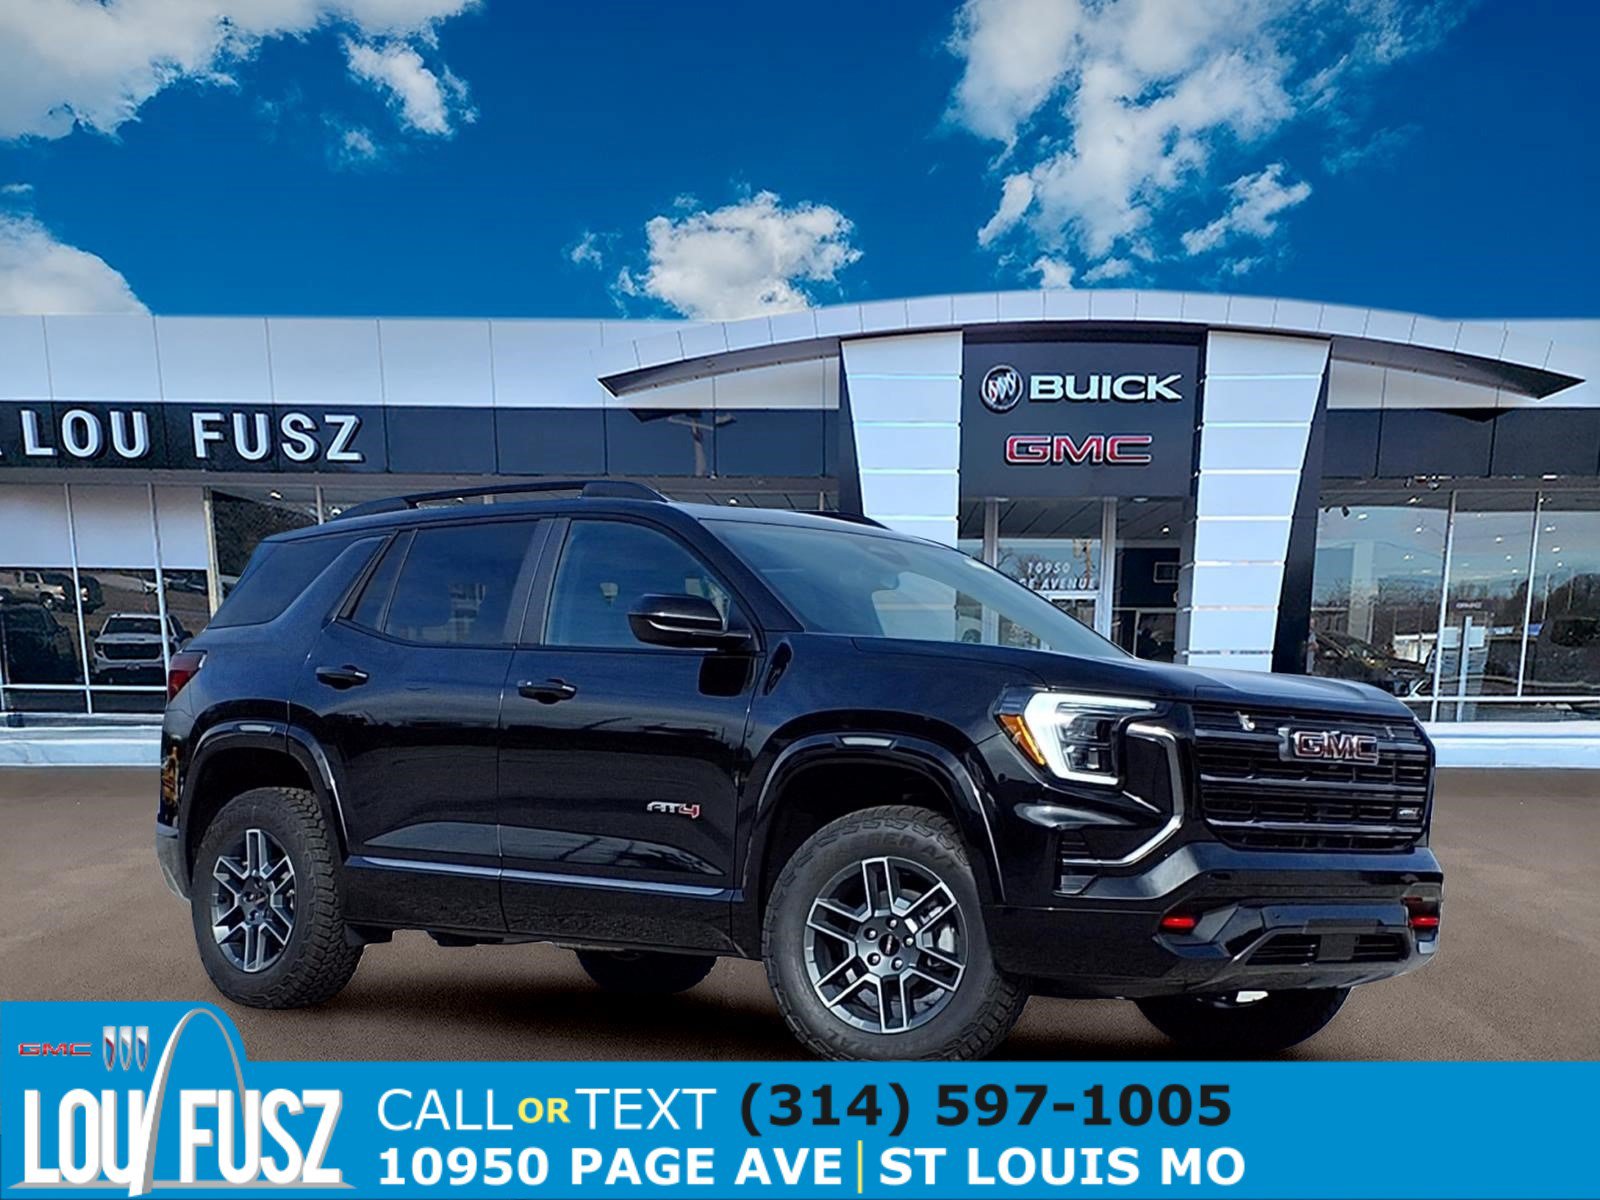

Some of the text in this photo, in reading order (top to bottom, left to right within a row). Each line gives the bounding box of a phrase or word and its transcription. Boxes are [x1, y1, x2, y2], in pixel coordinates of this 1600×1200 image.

[1030, 374, 1183, 400] BUICK
[20, 409, 363, 462] LOU FUSZ
[1005, 434, 1153, 464] GMC
[1027, 562, 1072, 575] 10950
[1041, 578, 1099, 590] AVENUE
[1293, 731, 1378, 760] GMC
[646, 801, 701, 819] AT4
